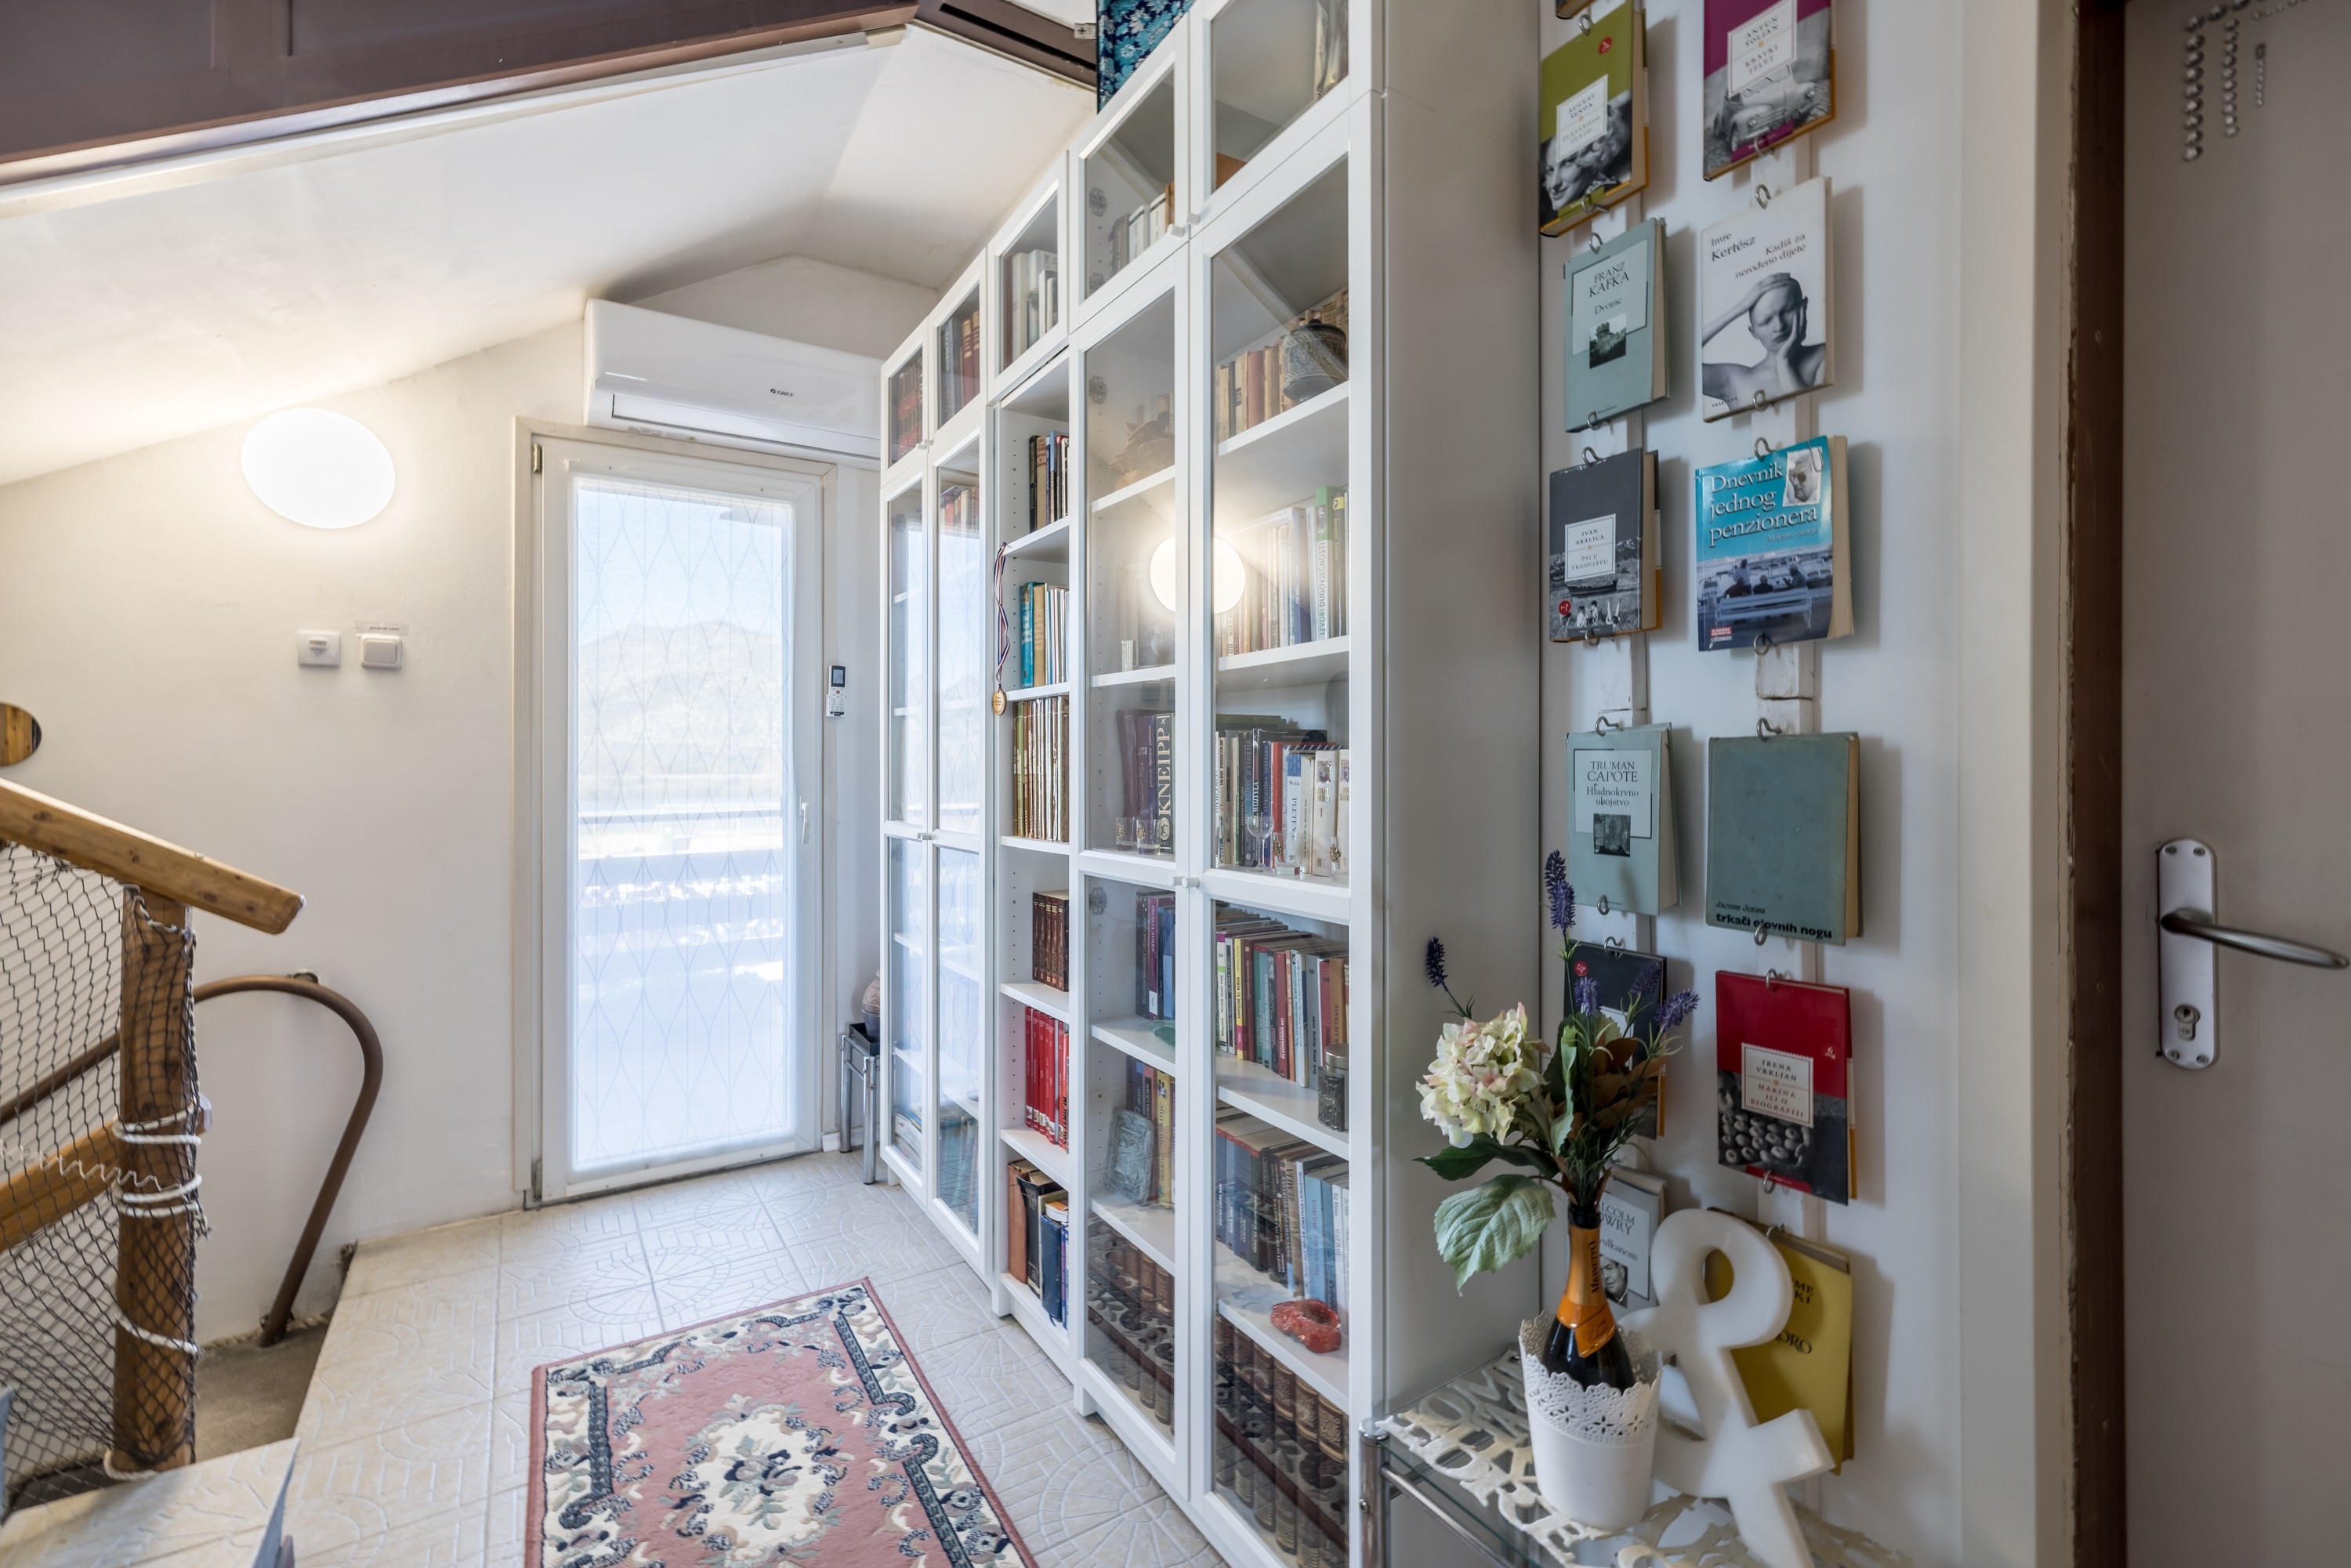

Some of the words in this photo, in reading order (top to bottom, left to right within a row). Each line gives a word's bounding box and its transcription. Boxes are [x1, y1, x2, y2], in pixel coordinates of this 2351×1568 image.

[1711, 231, 1732, 247] Imre
[1794, 233, 1806, 244] za
[1711, 237, 1756, 263] Kertész
[1778, 243, 1806, 266] dijete
[1594, 261, 1626, 284] FRANZ
[1588, 273, 1629, 299] KAFKA
[1710, 462, 1784, 494] Dnevnik
[1709, 491, 1777, 523] jednog
[1708, 505, 1818, 548] penzionera
[1575, 534, 1604, 545] ARALICA
[1157, 726, 1171, 817] KNEIPP
[1590, 761, 1635, 771] TRUMAN
[1587, 770, 1638, 783] CAPOTE
[1586, 786, 1639, 798] Hladnokrvno
[1596, 797, 1629, 808] ubojstvo
[1715, 901, 1741, 911] James
[1742, 904, 1766, 914] Jones
[1715, 912, 1751, 927] trkači
[1800, 925, 1832, 940] nogu
[1755, 1066, 1797, 1081] VRKLJAN
[1762, 1059, 1791, 1072] IRENA
[1757, 1083, 1795, 1099] MARINA
[1765, 1094, 1778, 1103] ILI
[1601, 1201, 1636, 1226] LCOLM
[1599, 1214, 1634, 1235] OWRY
